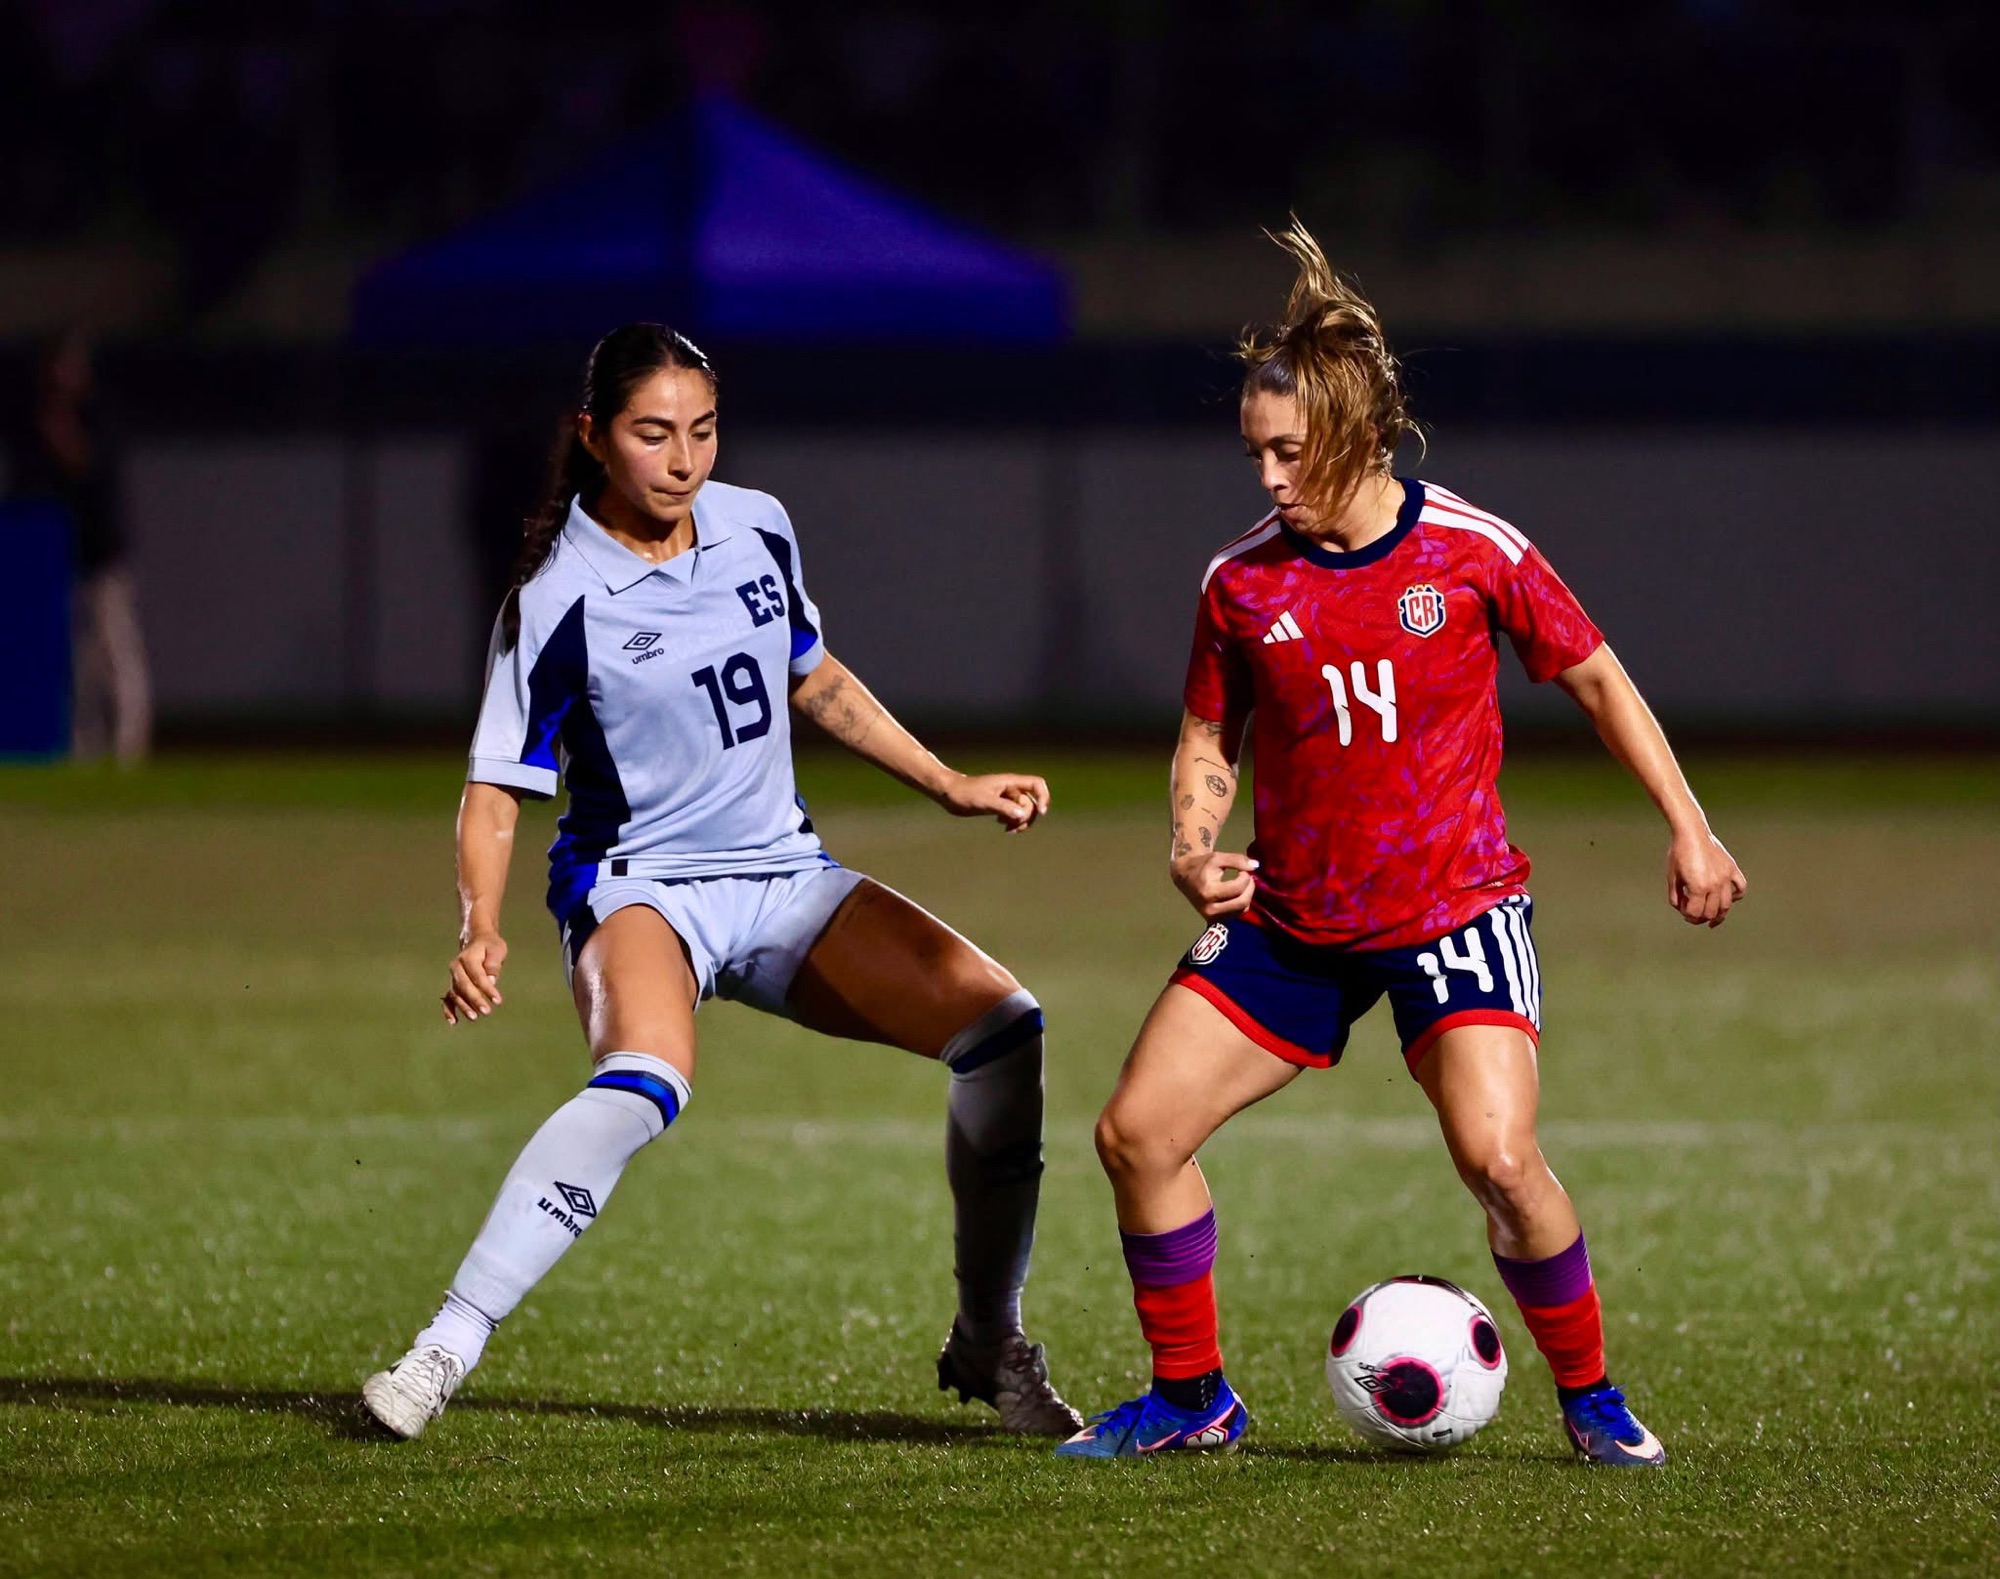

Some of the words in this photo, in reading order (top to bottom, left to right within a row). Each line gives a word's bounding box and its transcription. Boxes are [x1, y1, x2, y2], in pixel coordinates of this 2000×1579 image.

[735, 574, 785, 628] ES
[1408, 594, 1436, 628] CR
[632, 647, 664, 665] umbro
[691, 652, 772, 750] 19
[1321, 659, 1397, 746] 14
[1194, 930, 1220, 958] CR
[1417, 927, 1494, 1004] 14
[537, 1197, 583, 1238] umbro
